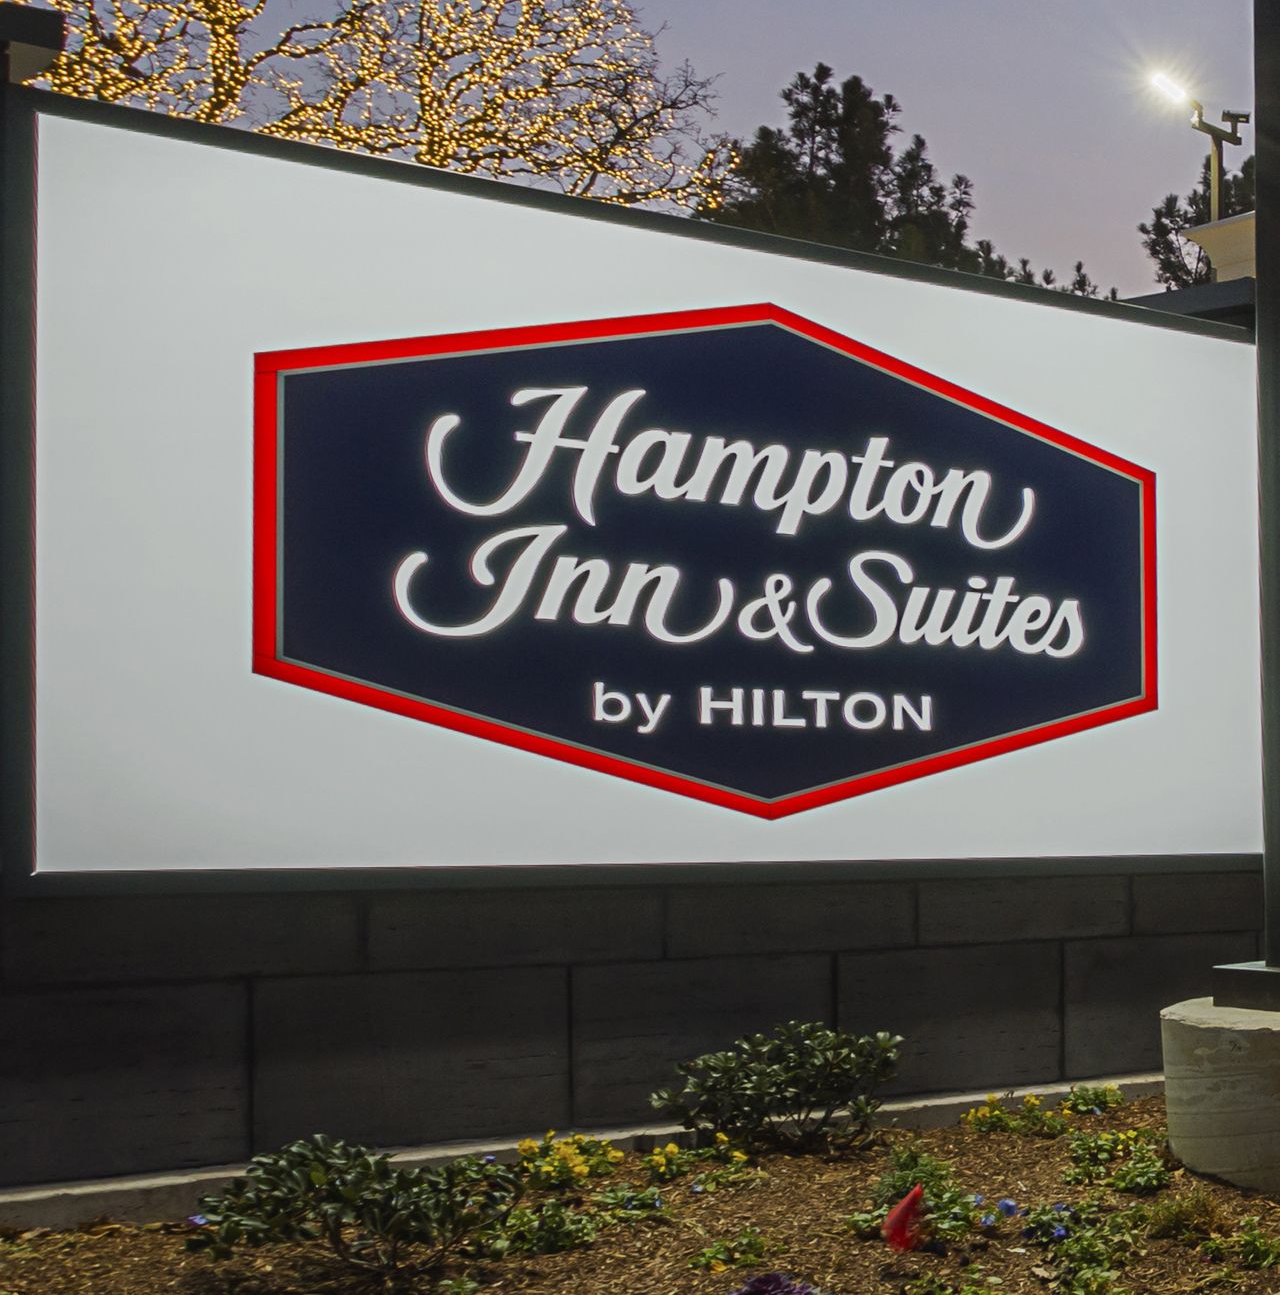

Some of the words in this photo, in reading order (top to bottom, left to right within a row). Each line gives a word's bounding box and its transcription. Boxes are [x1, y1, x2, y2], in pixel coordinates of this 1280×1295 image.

[425, 386, 1034, 550] Hampton
[393, 524, 733, 643] Inn
[738, 574, 814, 652] &
[806, 550, 1084, 658] Suites
[592, 681, 671, 734] by
[699, 686, 934, 732] HILTON
